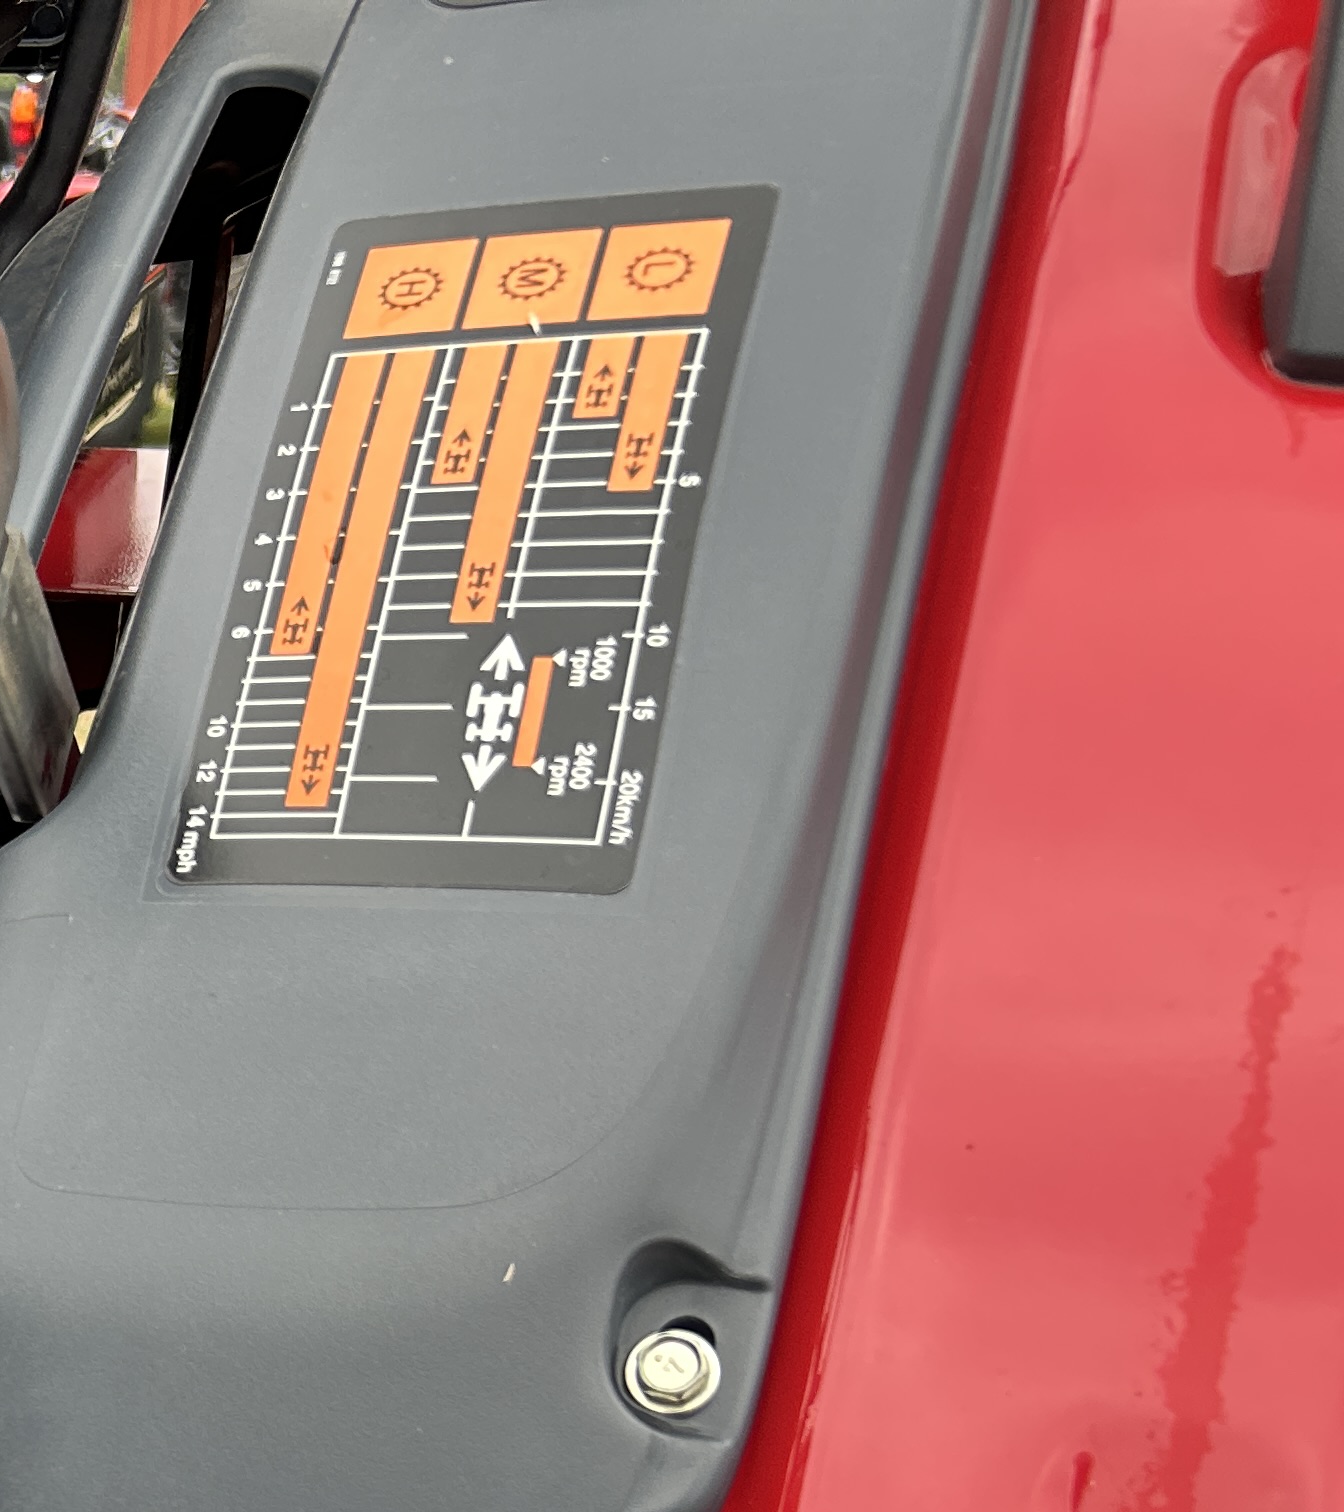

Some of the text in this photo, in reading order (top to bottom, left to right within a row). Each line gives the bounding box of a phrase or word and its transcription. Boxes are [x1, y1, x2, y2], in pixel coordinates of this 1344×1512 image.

[516, 268, 549, 288] M
[642, 261, 676, 277] L
[395, 280, 427, 298] H
[290, 401, 308, 412] 1
[278, 444, 297, 457] 2
[678, 475, 702, 488] 5
[266, 488, 286, 501] 3
[255, 533, 274, 546] 4
[243, 579, 262, 593] 5
[231, 625, 251, 639] 6
[646, 624, 670, 647] 10
[568, 648, 591, 687] rpm
[589, 636, 618, 681] 1000
[632, 696, 656, 721] 15
[206, 715, 229, 738] 10
[195, 759, 218, 783] 12
[546, 756, 570, 796] rpm
[568, 742, 590, 790] 2400
[608, 770, 644, 845] 20km/h
[175, 805, 206, 873] 14 mph
